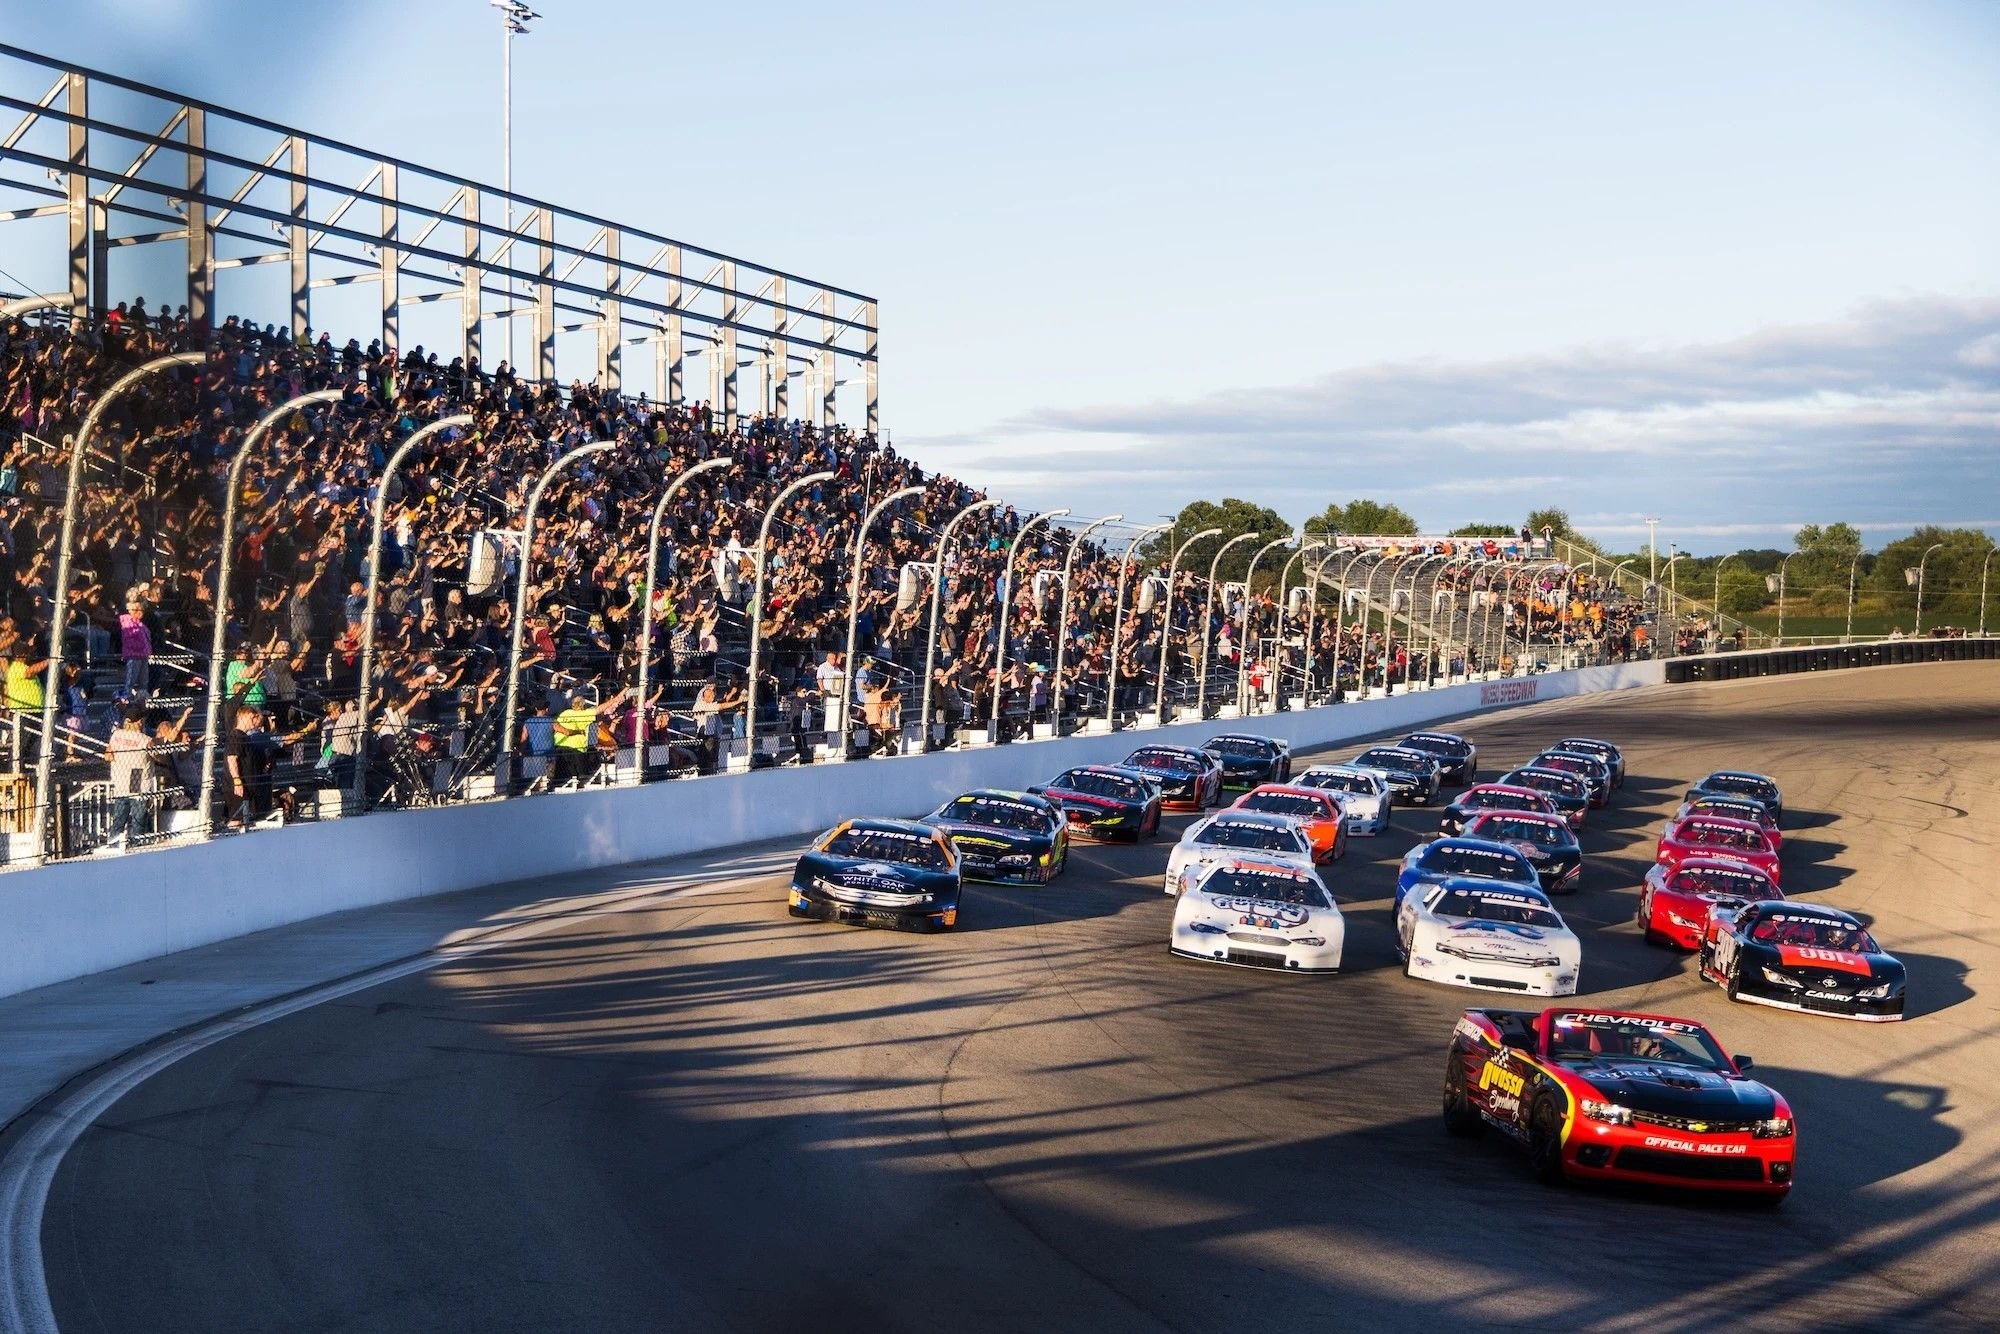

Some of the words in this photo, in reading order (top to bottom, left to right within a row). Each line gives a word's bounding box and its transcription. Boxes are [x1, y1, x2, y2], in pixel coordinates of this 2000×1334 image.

[1500, 679, 1538, 702] SPEEDWAY
[1150, 750, 1185, 758] STARS
[1553, 755, 1583, 763] STARS
[1082, 771, 1123, 781] STARS
[1529, 772, 1562, 780] STARS
[1268, 792, 1310, 801] STARS
[1487, 790, 1525, 798] STARS
[988, 800, 1036, 812] STARS
[1715, 803, 1751, 811] STARS
[1228, 822, 1274, 832] STARS
[1504, 817, 1546, 826] STARS
[1702, 823, 1744, 833] STARS
[862, 830, 917, 841] STARS
[1454, 848, 1503, 859] STARS
[1237, 868, 1293, 880] STARS
[1703, 869, 1752, 879] STARS
[842, 875, 878, 884] WHITE
[881, 880, 905, 889] OAK
[1470, 890, 1526, 902] STARS
[1787, 915, 1842, 928] STARS
[1798, 948, 1855, 966] JBL
[1805, 990, 1854, 1002] CAMRY
[1562, 1013, 1700, 1033] CHEVROLET
[1488, 1089, 1520, 1122] Speedway
[1645, 1136, 1695, 1152] OFFICIAL
[1697, 1143, 1724, 1153] PACE
[1726, 1144, 1747, 1154] CAR
